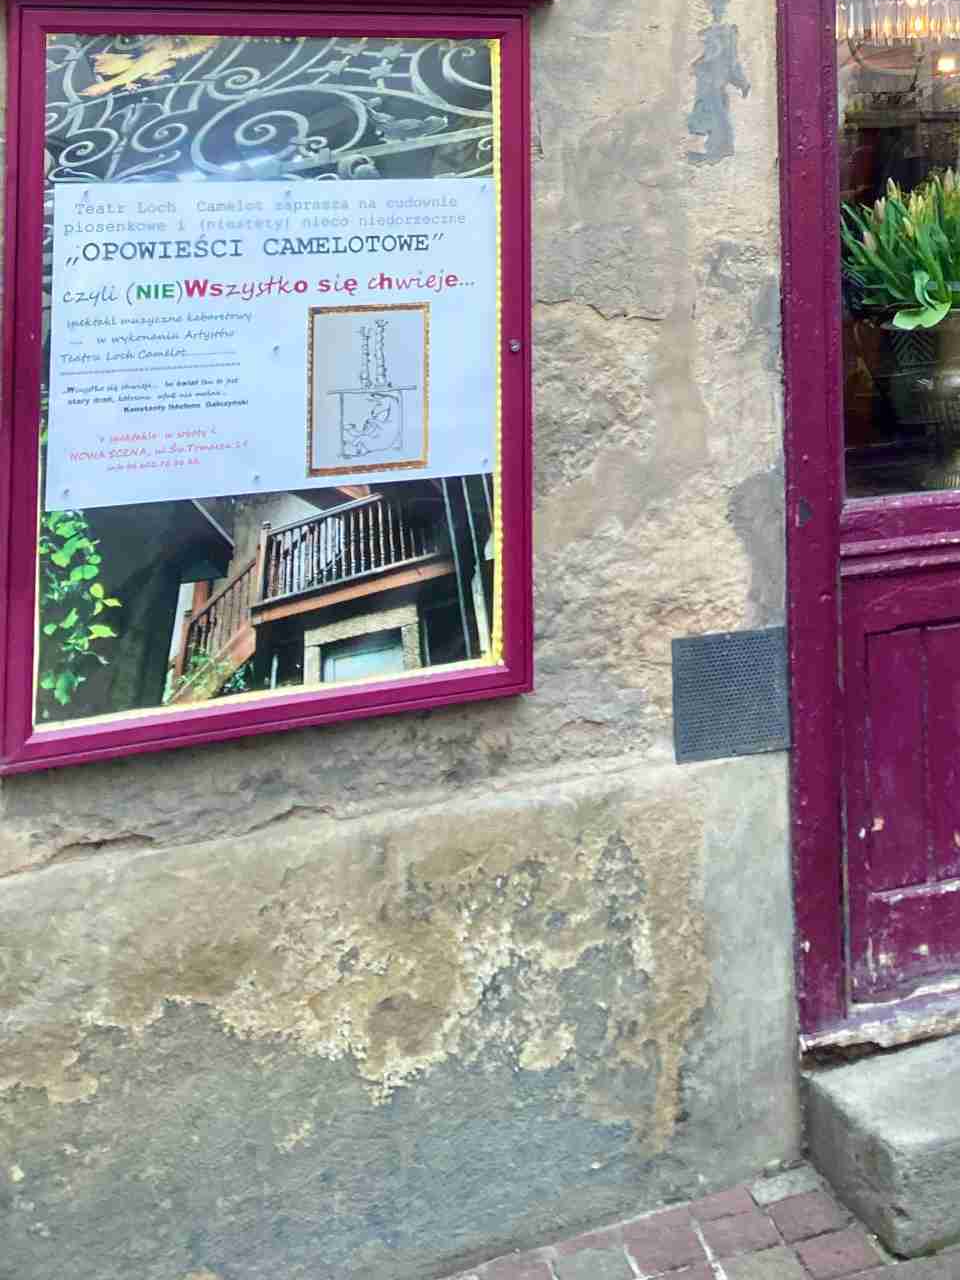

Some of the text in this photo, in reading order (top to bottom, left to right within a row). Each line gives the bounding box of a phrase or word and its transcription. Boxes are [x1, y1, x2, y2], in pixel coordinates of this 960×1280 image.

[74, 202, 129, 216] Teatr
[137, 201, 177, 214] Loch
[63, 285, 118, 307] czyli
[318, 273, 358, 296] się
